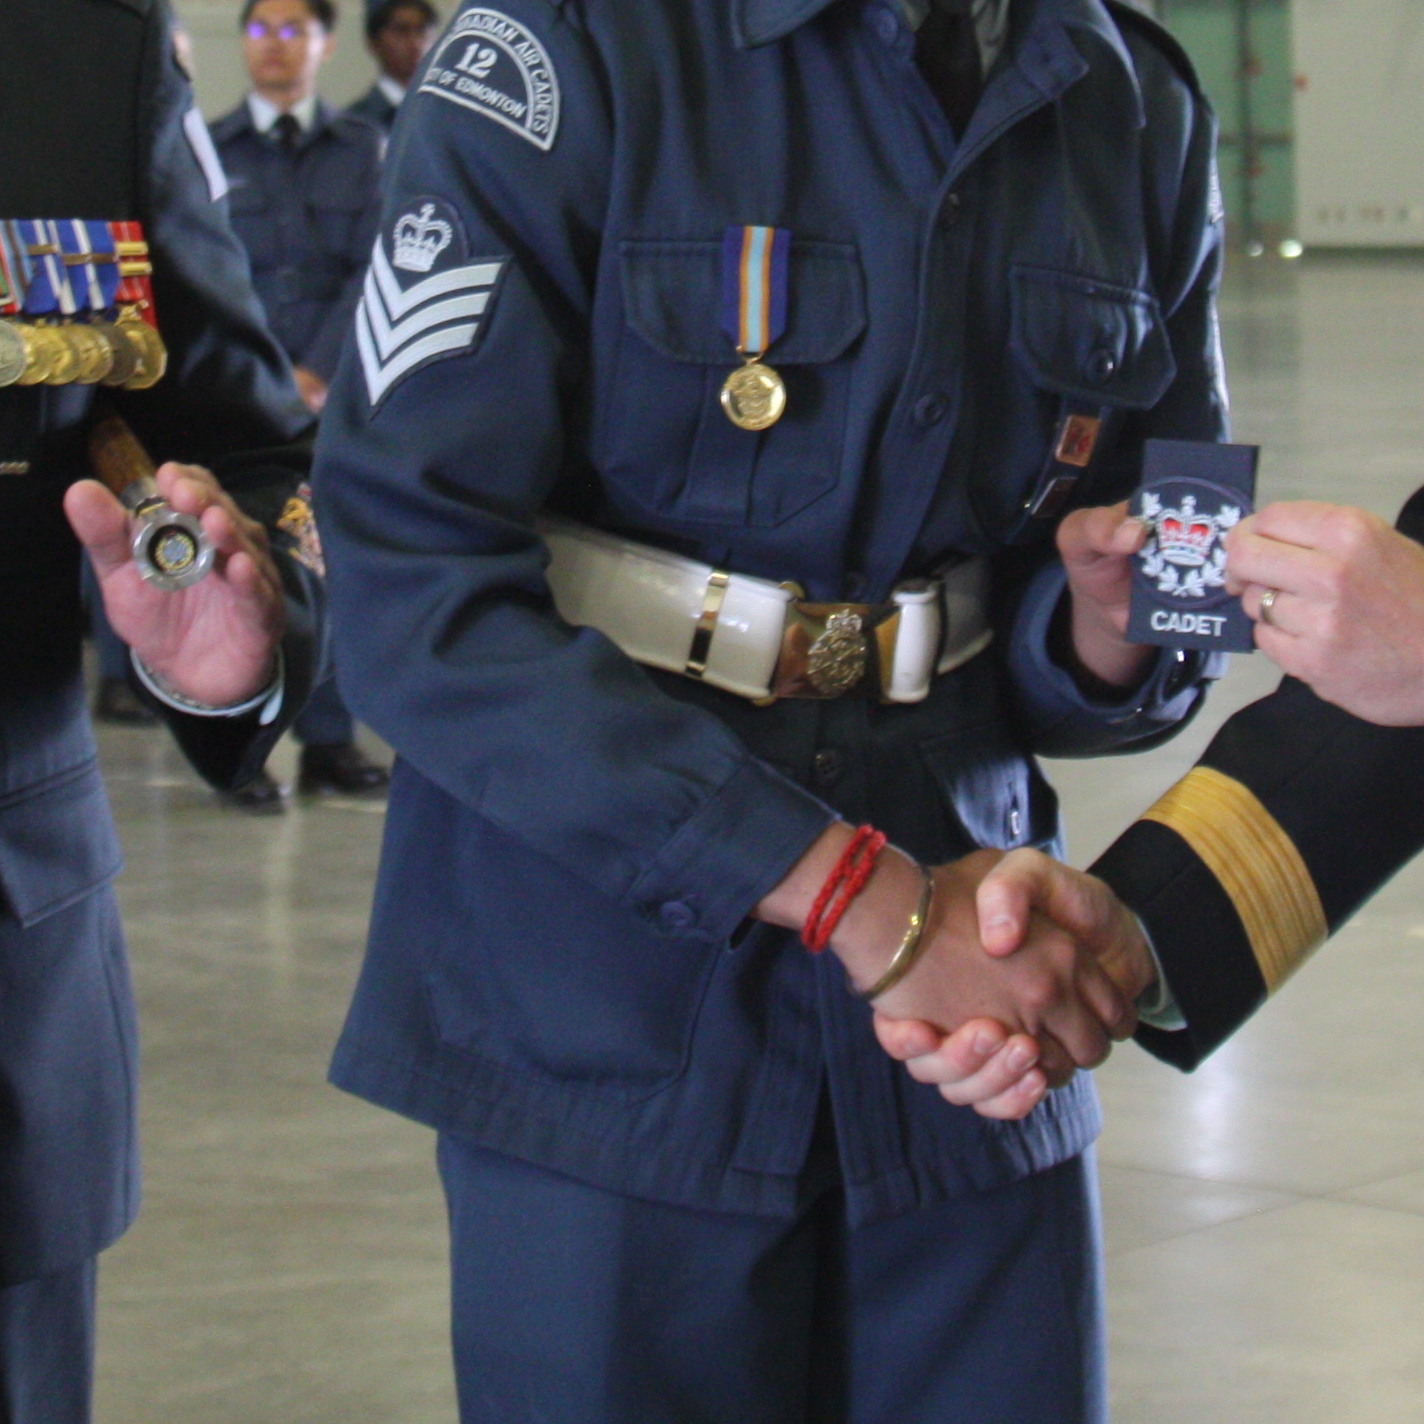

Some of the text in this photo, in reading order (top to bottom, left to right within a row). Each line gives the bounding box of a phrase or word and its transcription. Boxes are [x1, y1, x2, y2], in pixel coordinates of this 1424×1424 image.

[453, 42, 498, 80] 12
[454, 14, 553, 134] ADIAN AIR CADETS
[438, 70, 459, 87] OF
[455, 76, 528, 120] EDMONTON
[1149, 610, 1228, 637] CADET
